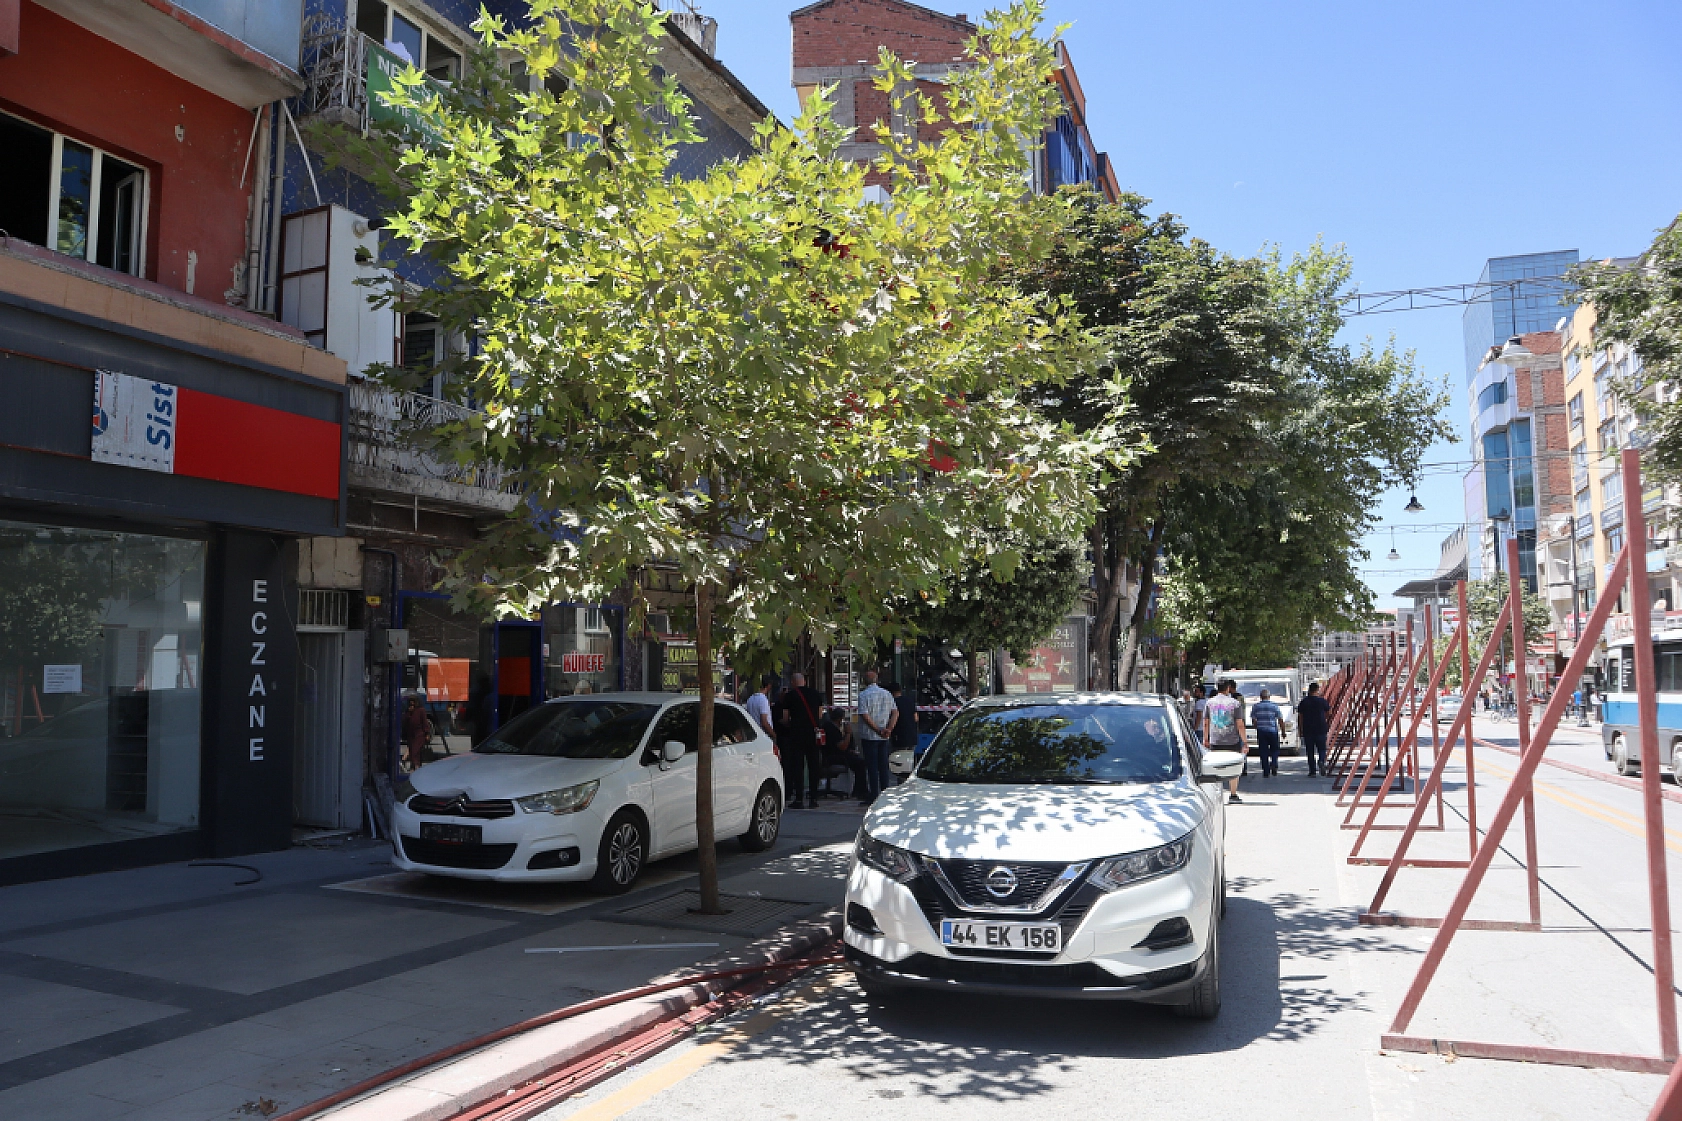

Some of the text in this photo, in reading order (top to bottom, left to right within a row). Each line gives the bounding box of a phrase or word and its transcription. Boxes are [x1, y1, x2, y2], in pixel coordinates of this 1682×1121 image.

[146, 383, 173, 450] Sist
[248, 579, 268, 761] ECZANE
[562, 650, 604, 673] KÜNEFE
[952, 924, 1057, 948] 44 EK 158
